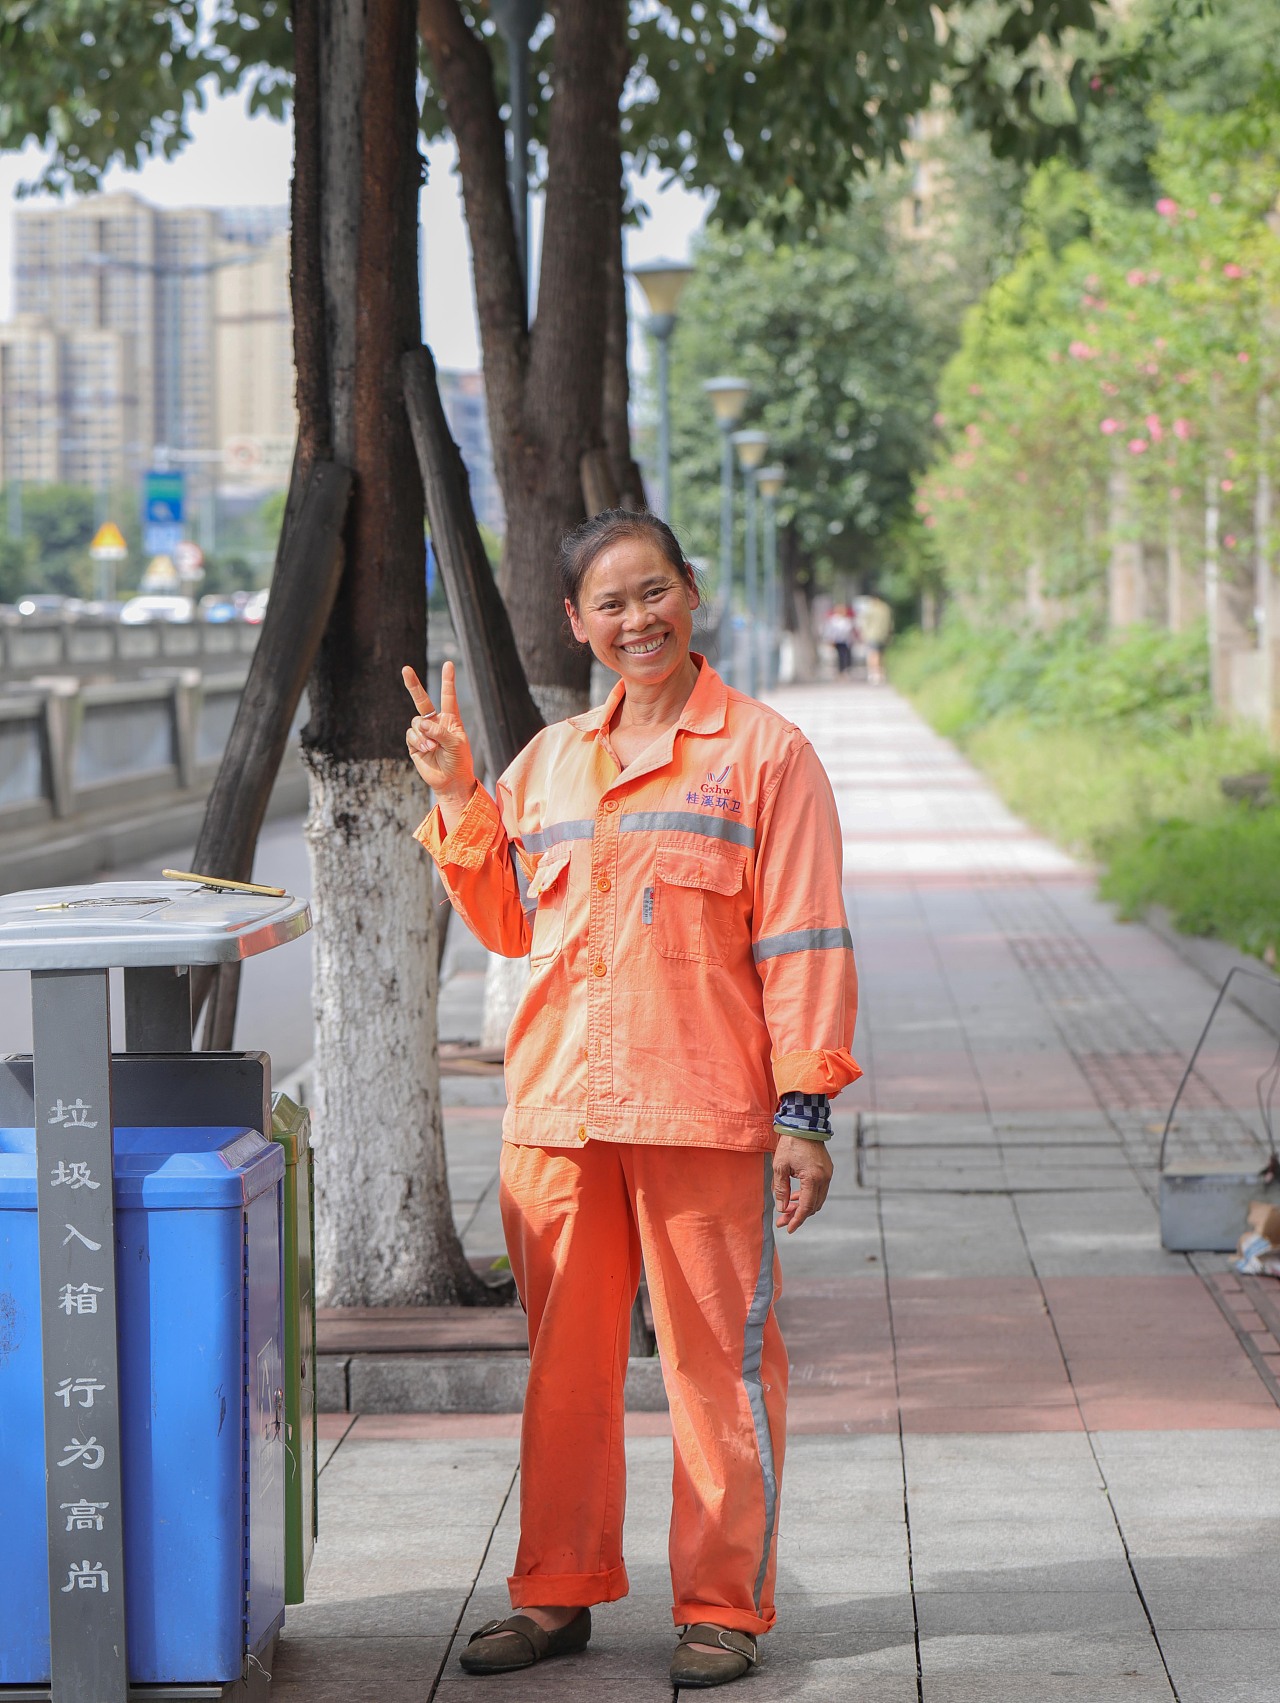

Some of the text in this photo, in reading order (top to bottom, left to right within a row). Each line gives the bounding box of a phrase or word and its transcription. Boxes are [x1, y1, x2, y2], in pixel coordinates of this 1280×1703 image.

[700, 783, 732, 795] Gxhw
[686, 791, 741, 813] 桂溪环卫
[47, 1098, 110, 1593] 垃圾入箱 行为高尚
